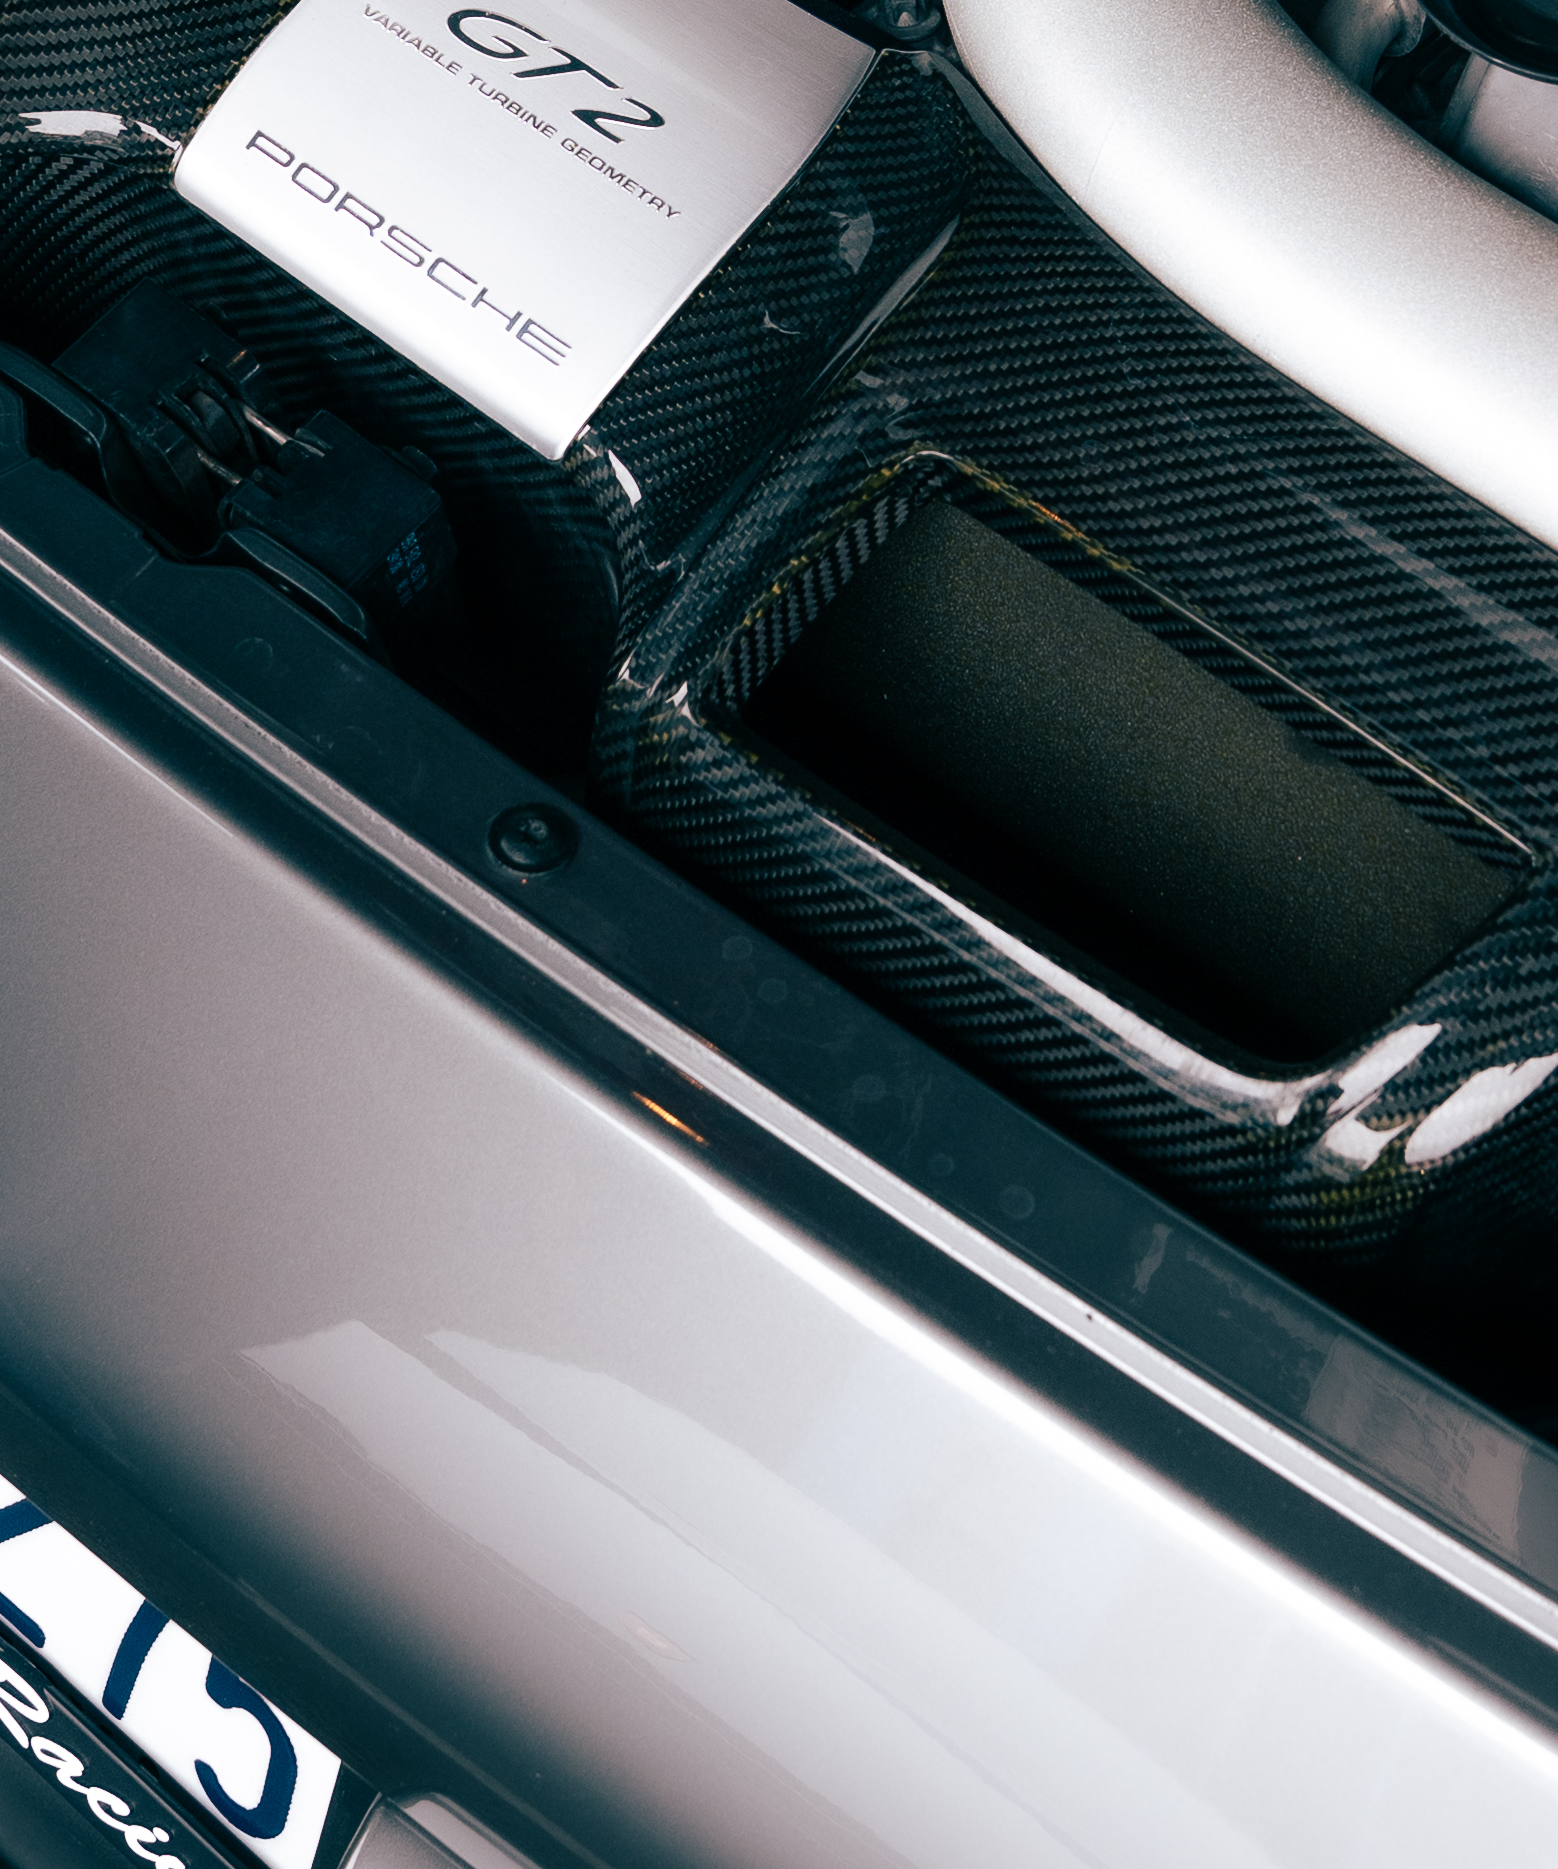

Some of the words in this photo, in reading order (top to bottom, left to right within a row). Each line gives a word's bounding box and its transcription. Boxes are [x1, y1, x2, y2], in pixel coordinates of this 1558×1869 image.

[361, 2, 464, 77] VARIABLE
[465, 71, 559, 141] TURBINE
[559, 136, 682, 221] GEOMETRY
[445, 7, 666, 147] GT2
[245, 129, 573, 367] PORSCHE
